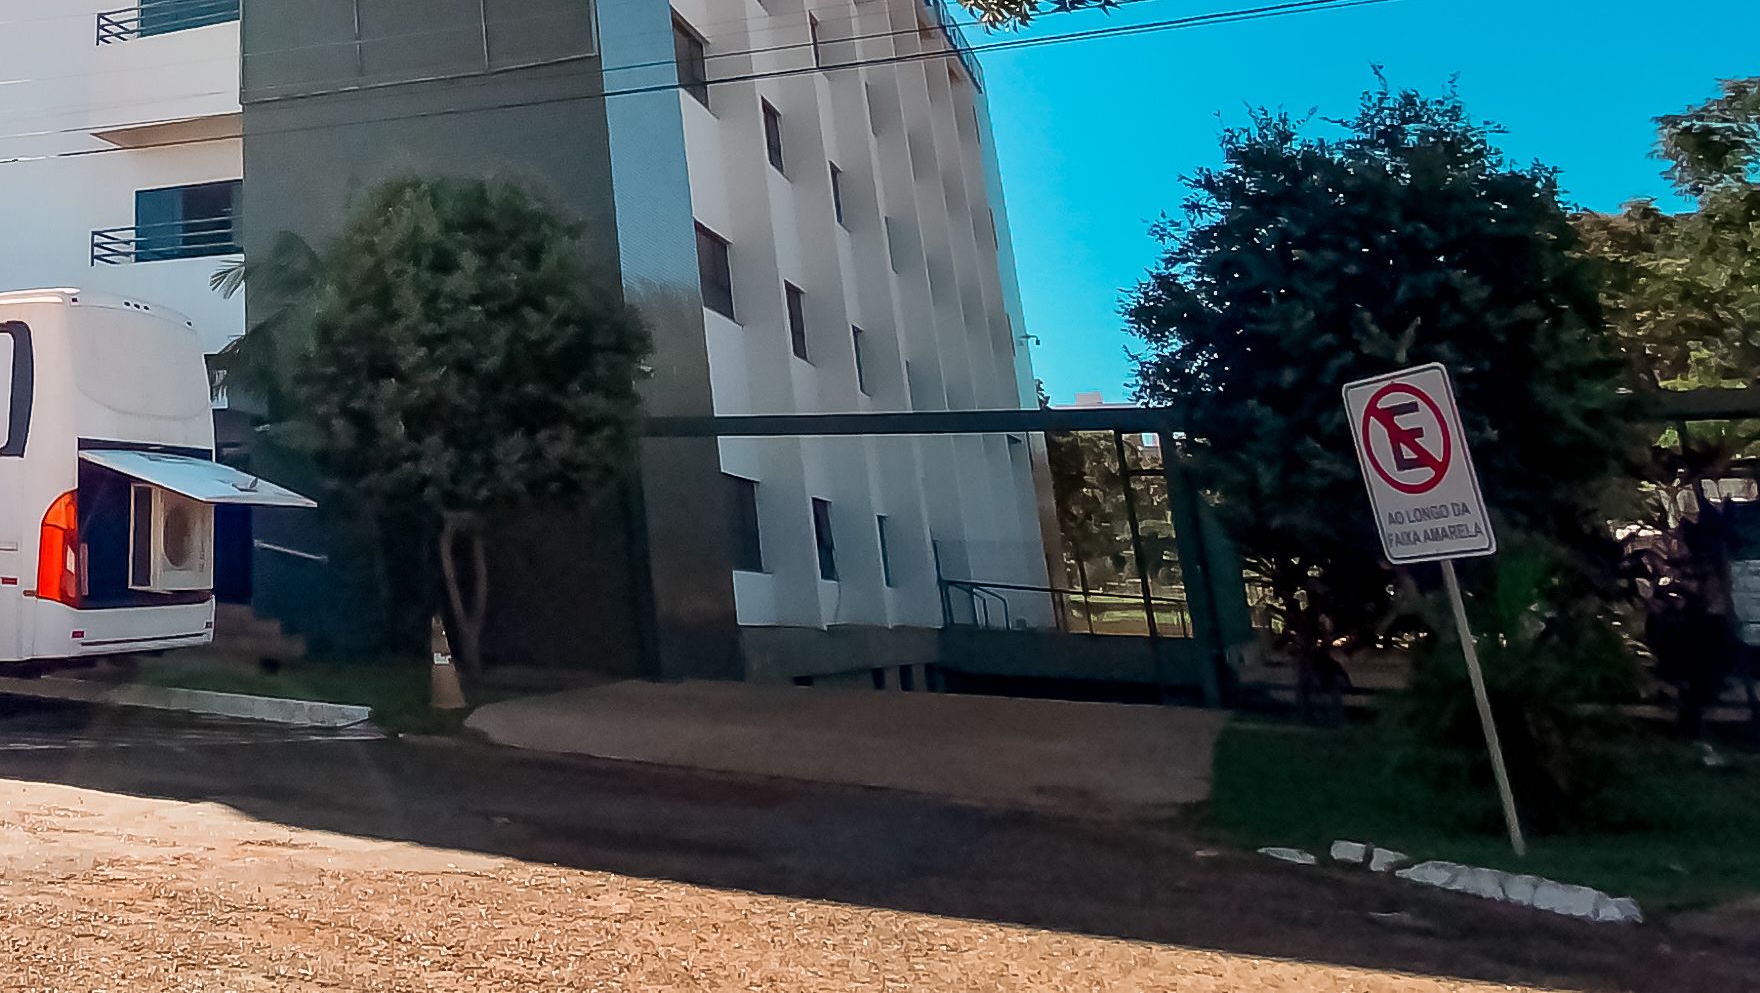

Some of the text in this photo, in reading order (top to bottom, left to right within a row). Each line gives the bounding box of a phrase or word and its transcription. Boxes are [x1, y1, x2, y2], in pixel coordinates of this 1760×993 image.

[1387, 502, 1472, 525] AO LONGO DA
[1387, 522, 1483, 547] FAIXA AMARELA
